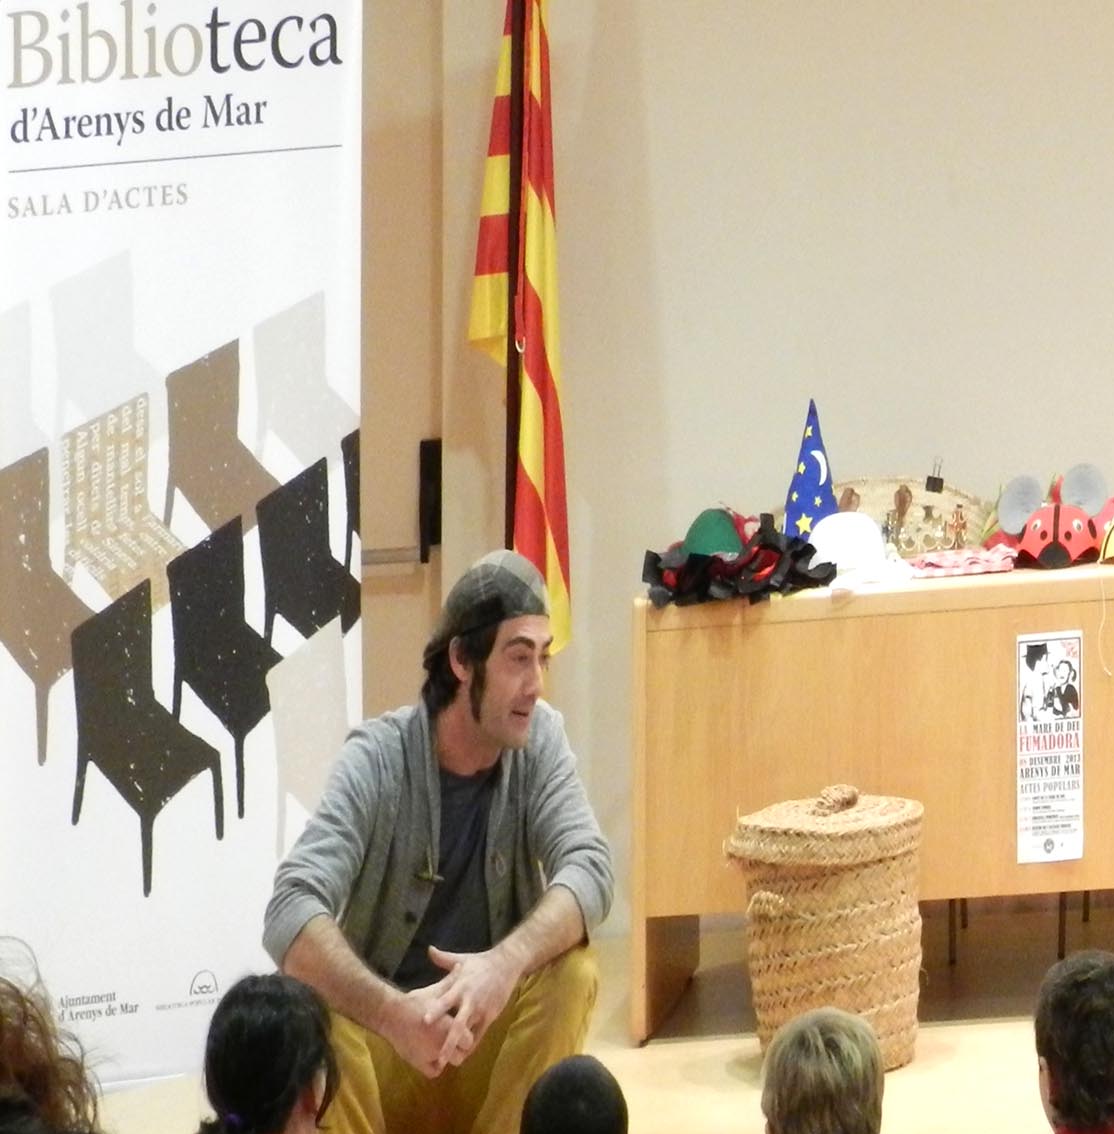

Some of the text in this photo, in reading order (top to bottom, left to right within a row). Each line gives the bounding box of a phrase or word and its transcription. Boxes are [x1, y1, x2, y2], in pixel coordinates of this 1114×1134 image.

[7, 0, 343, 89] Biblioteca
[10, 94, 268, 146] d'Arenys de Mar
[7, 184, 189, 219] SALA D'ACTES
[106, 414, 118, 436] de
[121, 405, 133, 434] del
[75, 432, 88, 482] Algun
[119, 442, 132, 476] mal
[135, 446, 145, 463] el
[76, 491, 88, 532] ocell
[1019, 732, 1081, 752] FUMADORA
[1063, 763, 1081, 776] MAR
[104, 1003, 118, 1017] de
[120, 1002, 140, 1015] Mar
